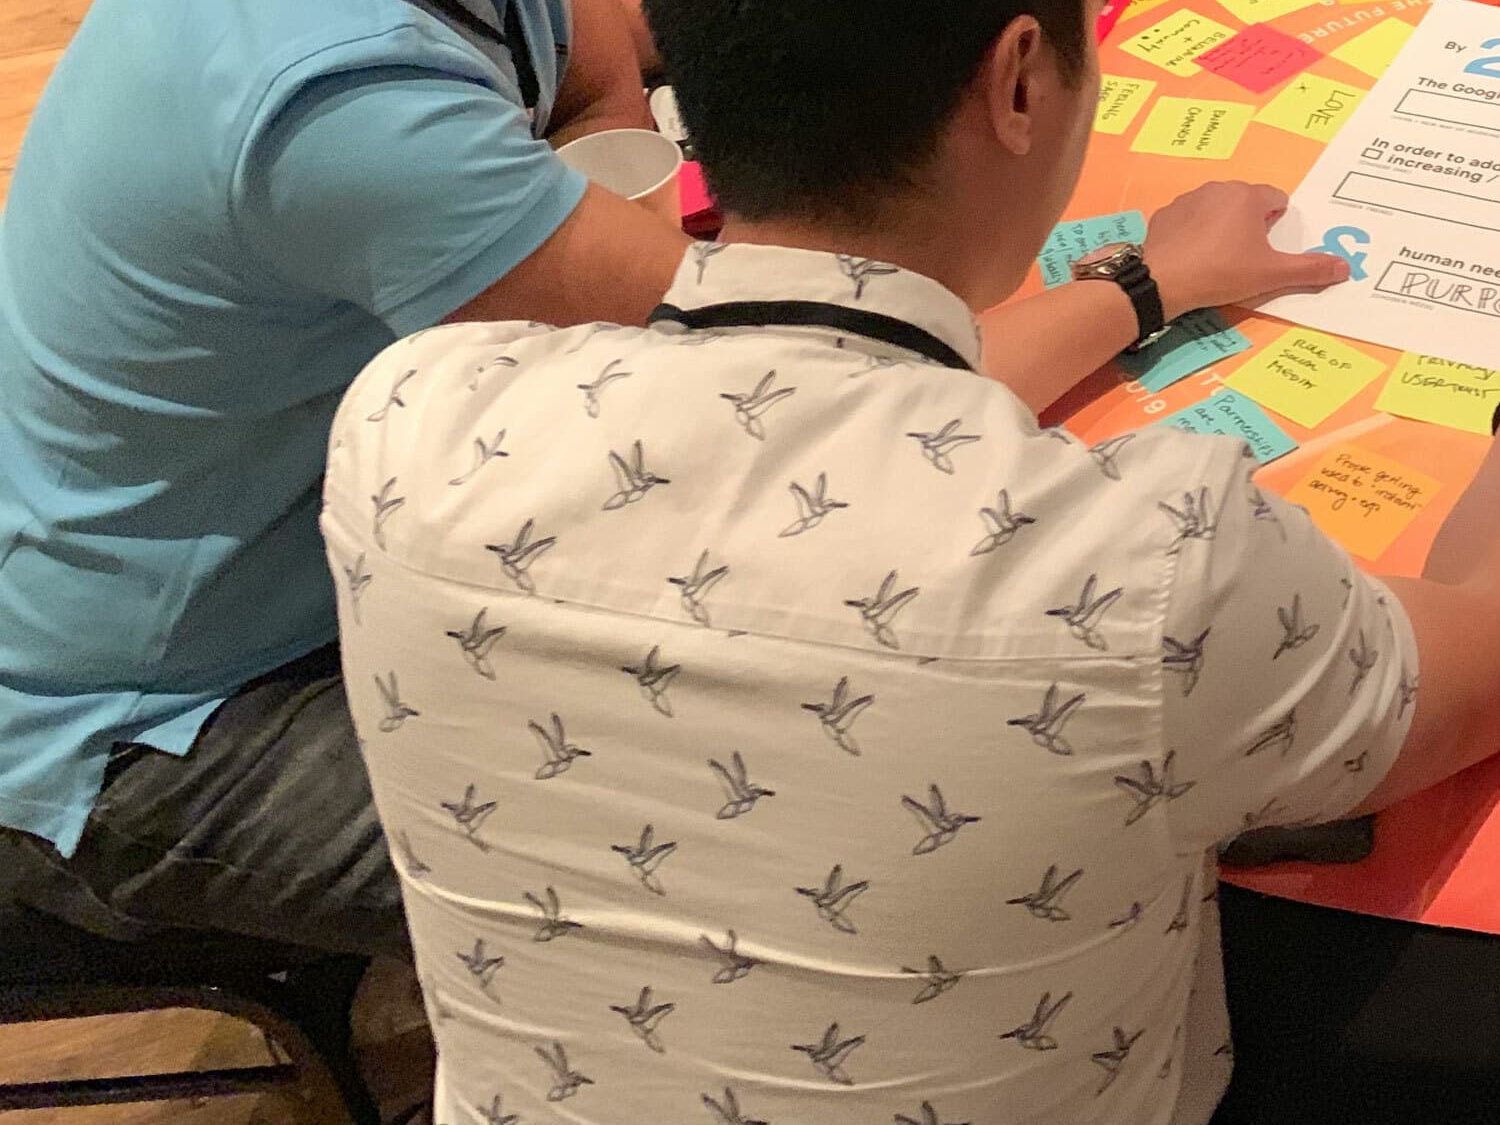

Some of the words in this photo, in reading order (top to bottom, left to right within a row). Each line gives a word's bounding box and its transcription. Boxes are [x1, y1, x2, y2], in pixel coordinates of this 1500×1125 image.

[1296, 6, 1385, 44] FUTURE
[1444, 41, 1466, 55] By
[1417, 76, 1448, 91] The
[1305, 89, 1355, 130] LOVE
[1371, 137, 1390, 151] In
[1393, 141, 1442, 161] order
[1447, 150, 1466, 164] to
[1386, 152, 1484, 185] increasing
[1398, 246, 1465, 271] human
[1126, 380, 1167, 414] 019
